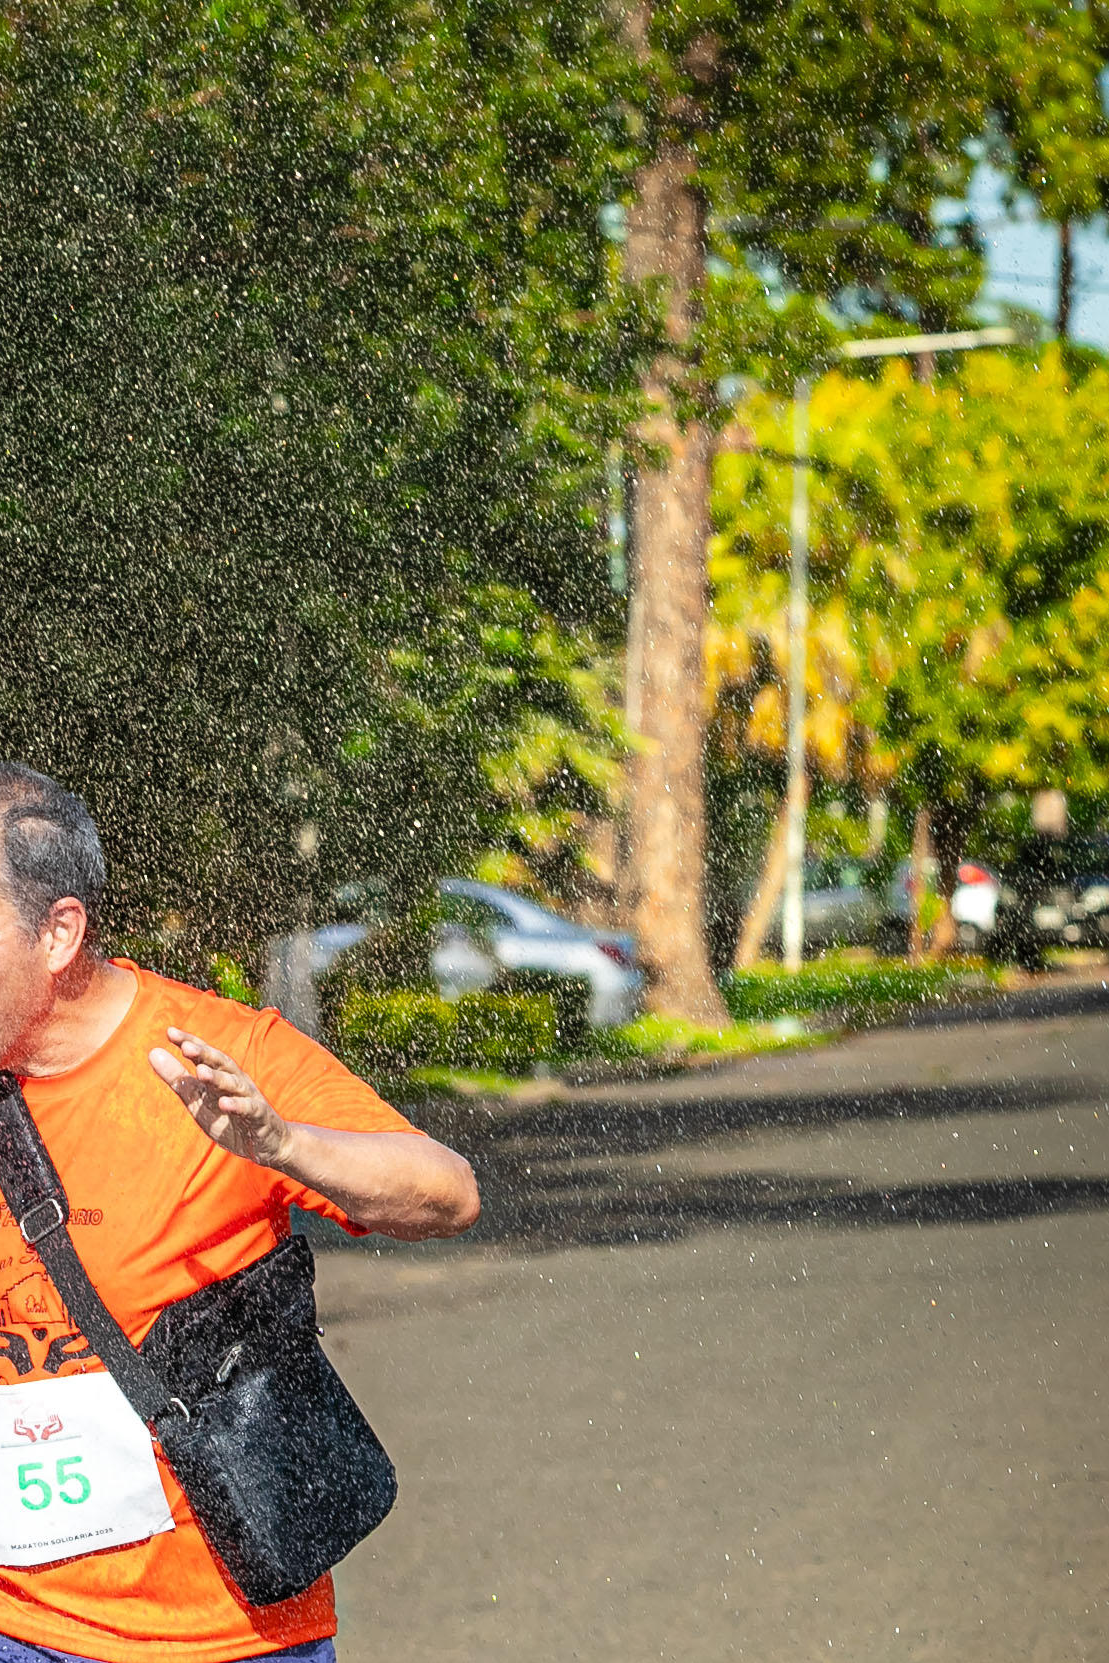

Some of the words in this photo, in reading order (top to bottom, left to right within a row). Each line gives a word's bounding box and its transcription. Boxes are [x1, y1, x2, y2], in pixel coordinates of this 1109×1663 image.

[17, 1456, 92, 1510] 55
[50, 1531, 94, 1545] SOLIDARIA
[95, 1527, 114, 1537] 2025
